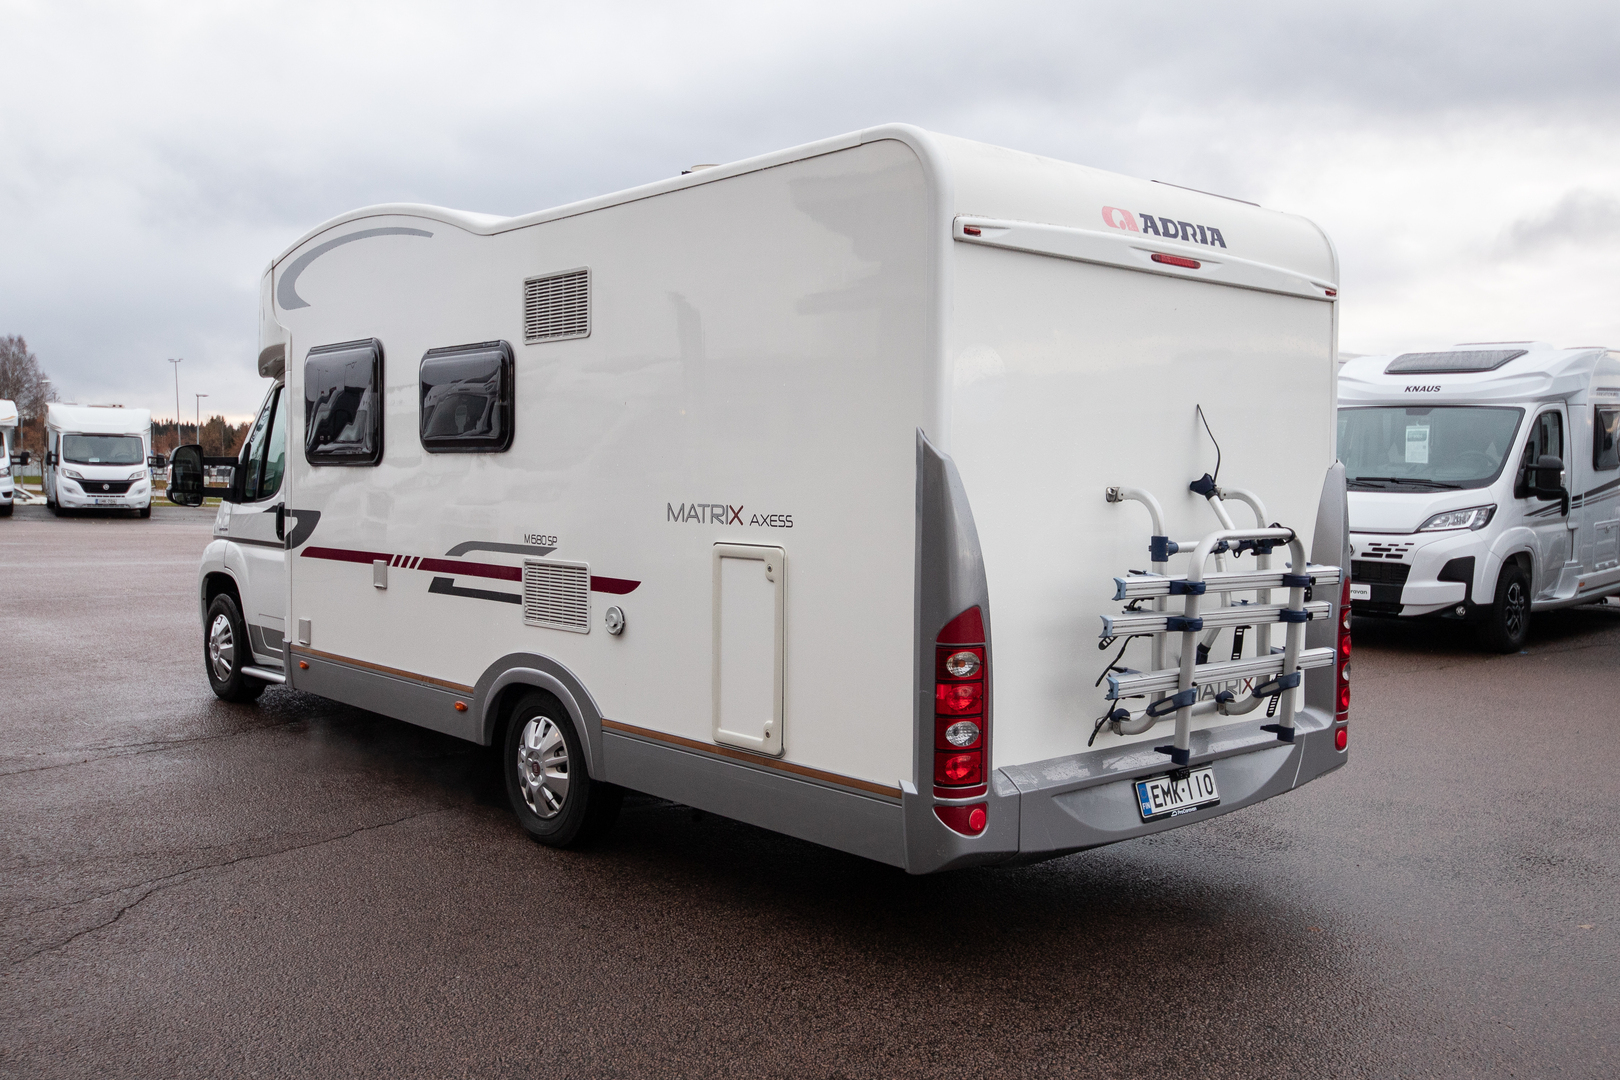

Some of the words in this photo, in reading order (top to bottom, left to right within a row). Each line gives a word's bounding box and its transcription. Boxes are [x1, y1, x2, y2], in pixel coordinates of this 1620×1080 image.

[1139, 213, 1227, 249] ADRIA
[1404, 385, 1441, 393] KNAUS
[667, 502, 744, 526] MATRIX
[749, 513, 794, 528] AXESS
[1142, 801, 1151, 811] FIN
